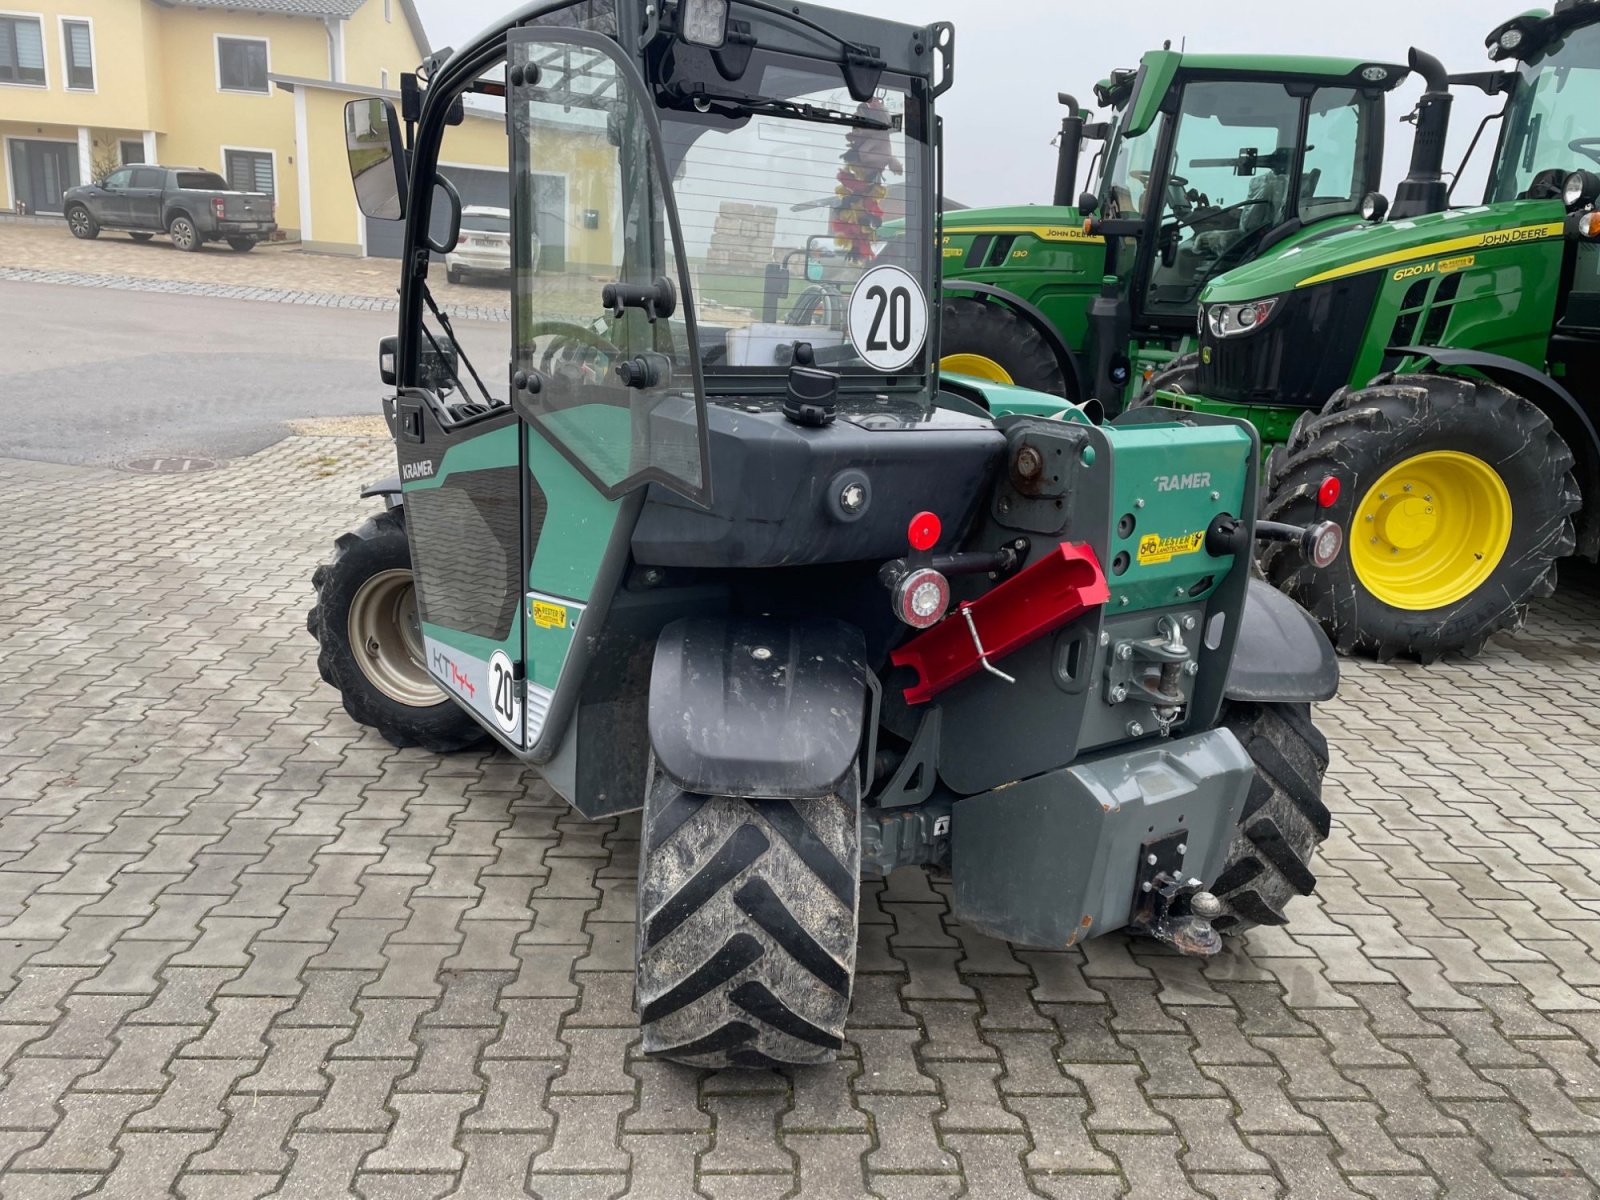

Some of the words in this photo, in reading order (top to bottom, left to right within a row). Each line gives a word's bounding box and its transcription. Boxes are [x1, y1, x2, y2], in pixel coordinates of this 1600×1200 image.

[1046, 228, 1068, 237] JOHN
[1479, 232, 1510, 245] JOHN
[1512, 227, 1549, 241] DEERE
[866, 285, 911, 351] 20
[402, 459, 433, 479] KRAMER
[1153, 472, 1211, 491] RAMER
[494, 662, 514, 722] 20
